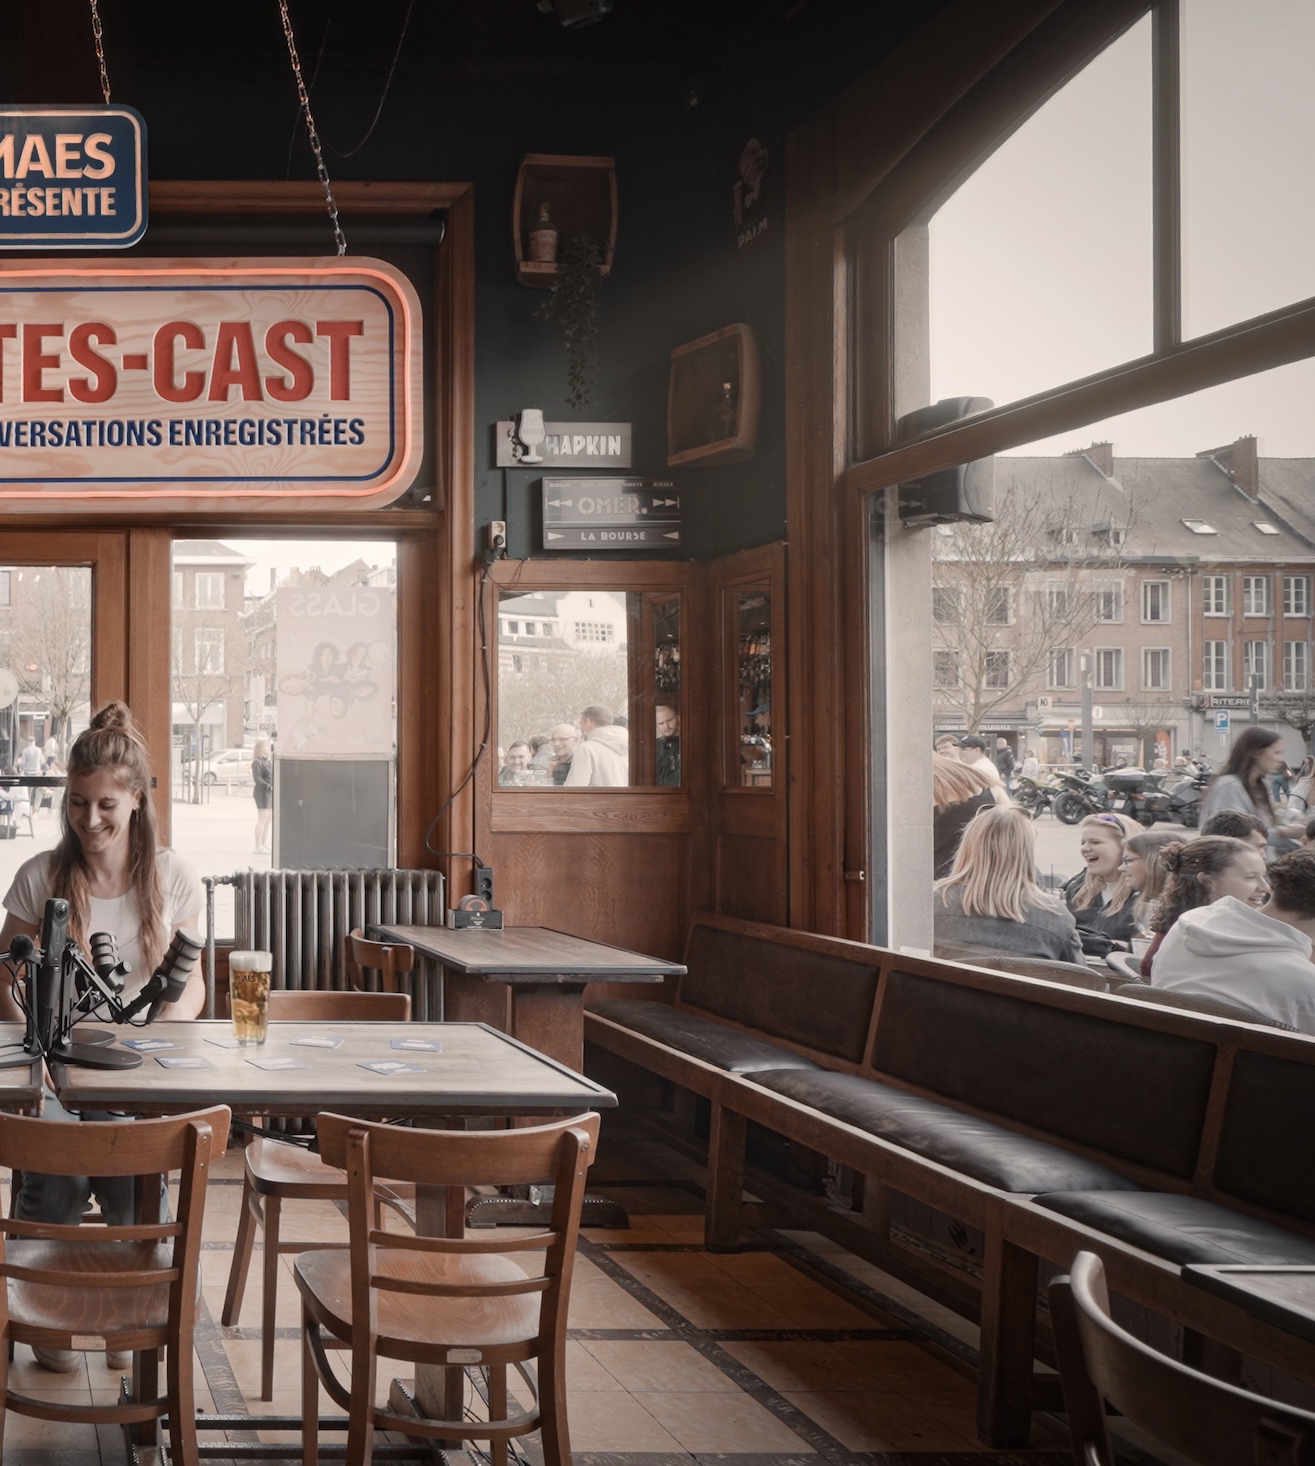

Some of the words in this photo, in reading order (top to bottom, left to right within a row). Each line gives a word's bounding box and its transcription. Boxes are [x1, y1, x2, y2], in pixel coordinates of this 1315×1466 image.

[168, 412, 366, 446] ENREGISTRÉES
[546, 434, 621, 456] HAPKIN
[581, 532, 596, 540] LA
[600, 532, 646, 540] BOURSE
[1217, 713, 1227, 726] P
[1112, 745, 1134, 753] PRESSE
